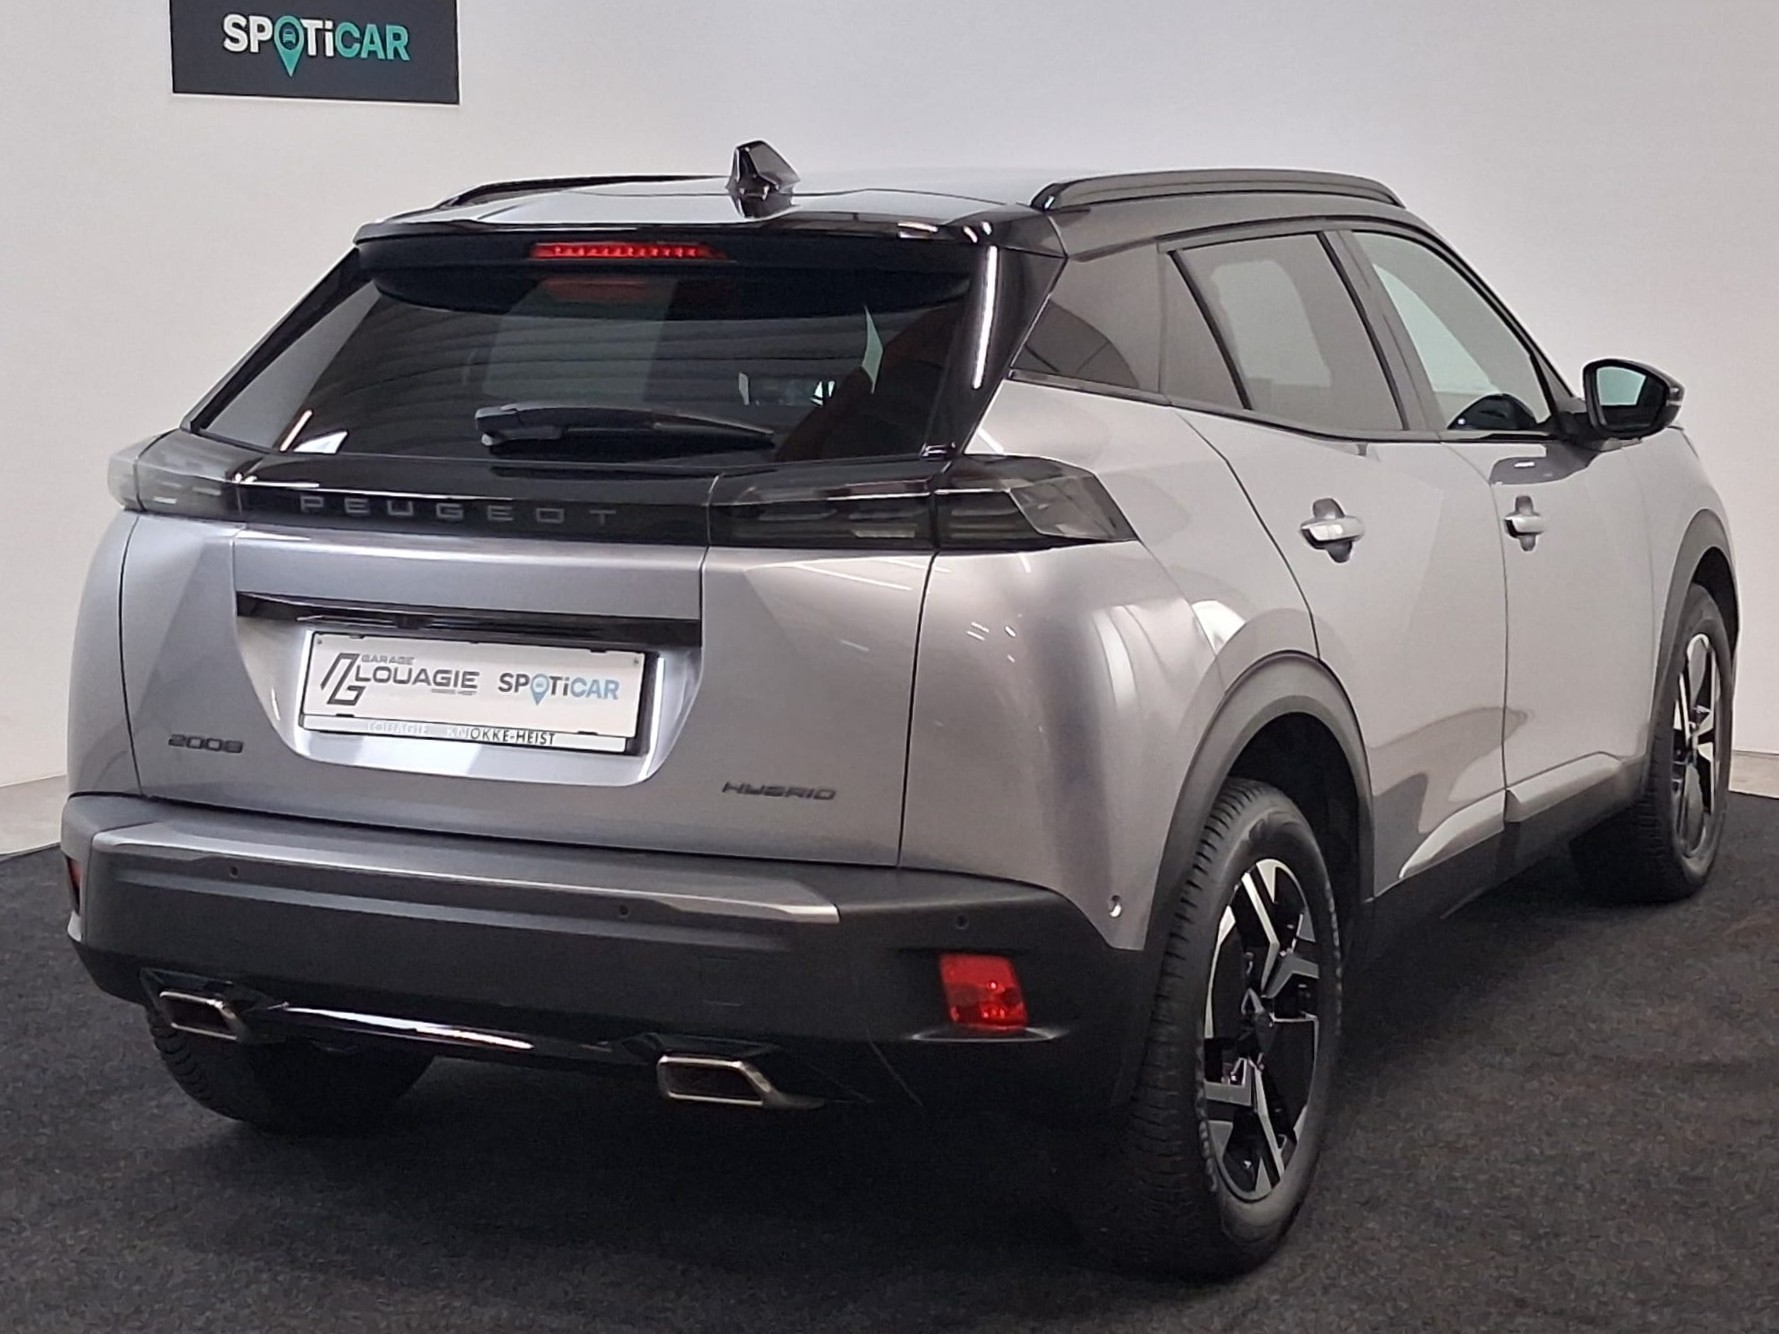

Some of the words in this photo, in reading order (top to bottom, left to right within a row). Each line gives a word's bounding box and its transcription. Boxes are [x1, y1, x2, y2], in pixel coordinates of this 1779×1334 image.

[300, 495, 617, 525] PEUGEOT
[361, 654, 415, 665] GARAGE
[355, 665, 480, 689] LOUAGIE
[168, 734, 244, 754] 2008
[722, 781, 836, 801] HYBRID
